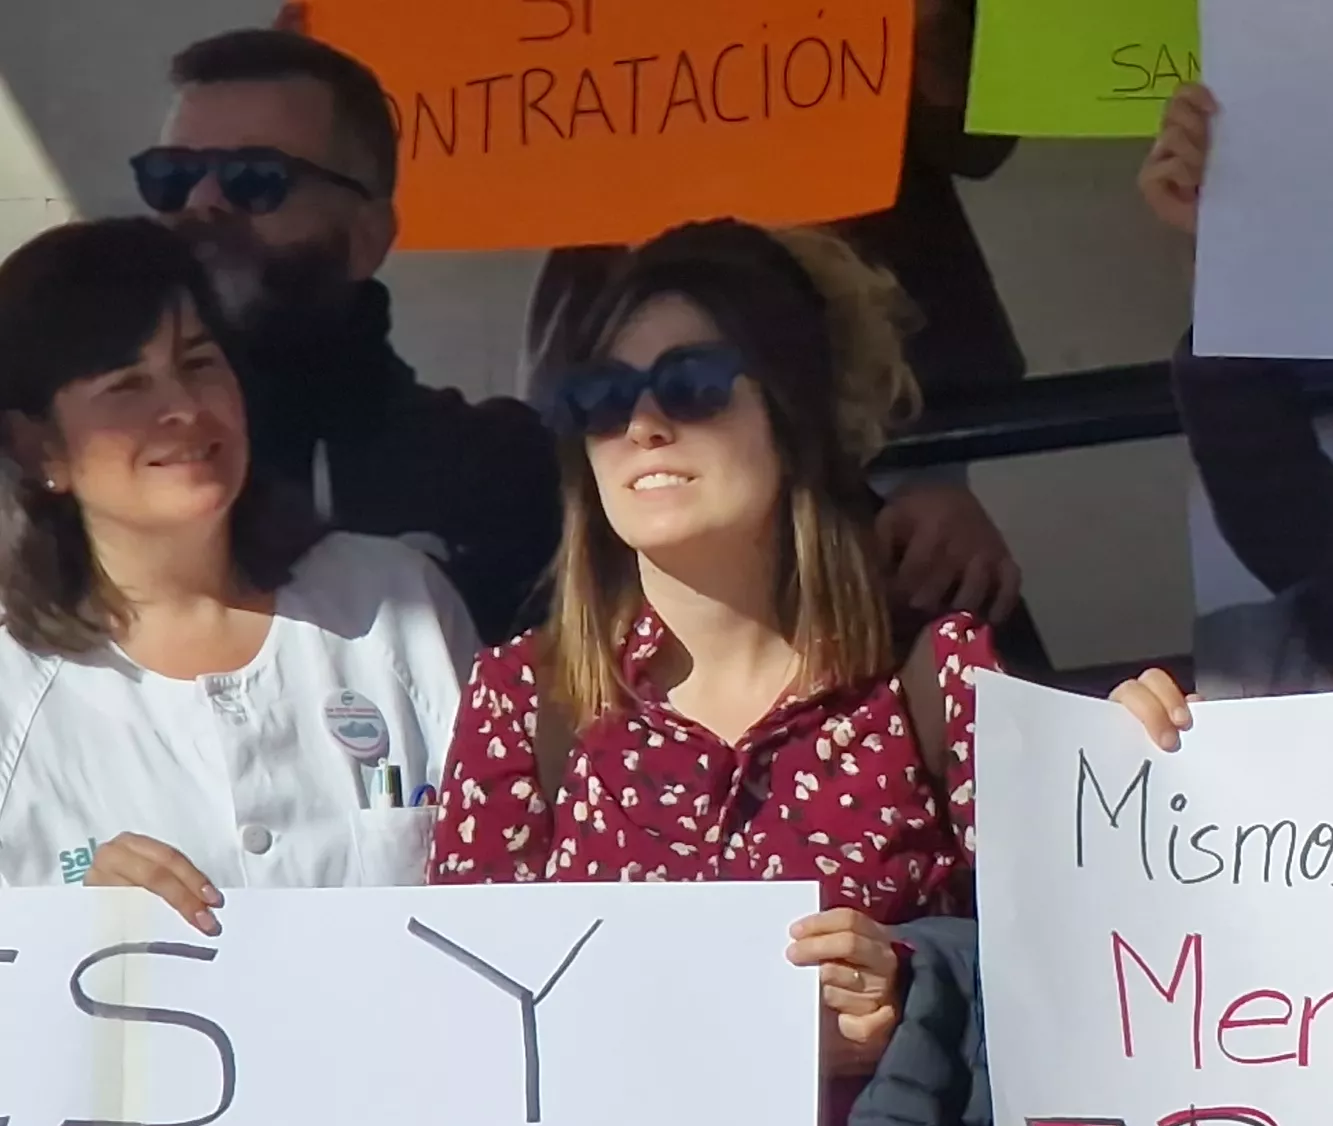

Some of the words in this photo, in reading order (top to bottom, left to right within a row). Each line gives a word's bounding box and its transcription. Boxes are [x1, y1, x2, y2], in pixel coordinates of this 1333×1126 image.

[388, 8, 888, 160] NTRATACIÓN
[59, 837, 97, 871] sal
[407, 917, 604, 1123] Y
